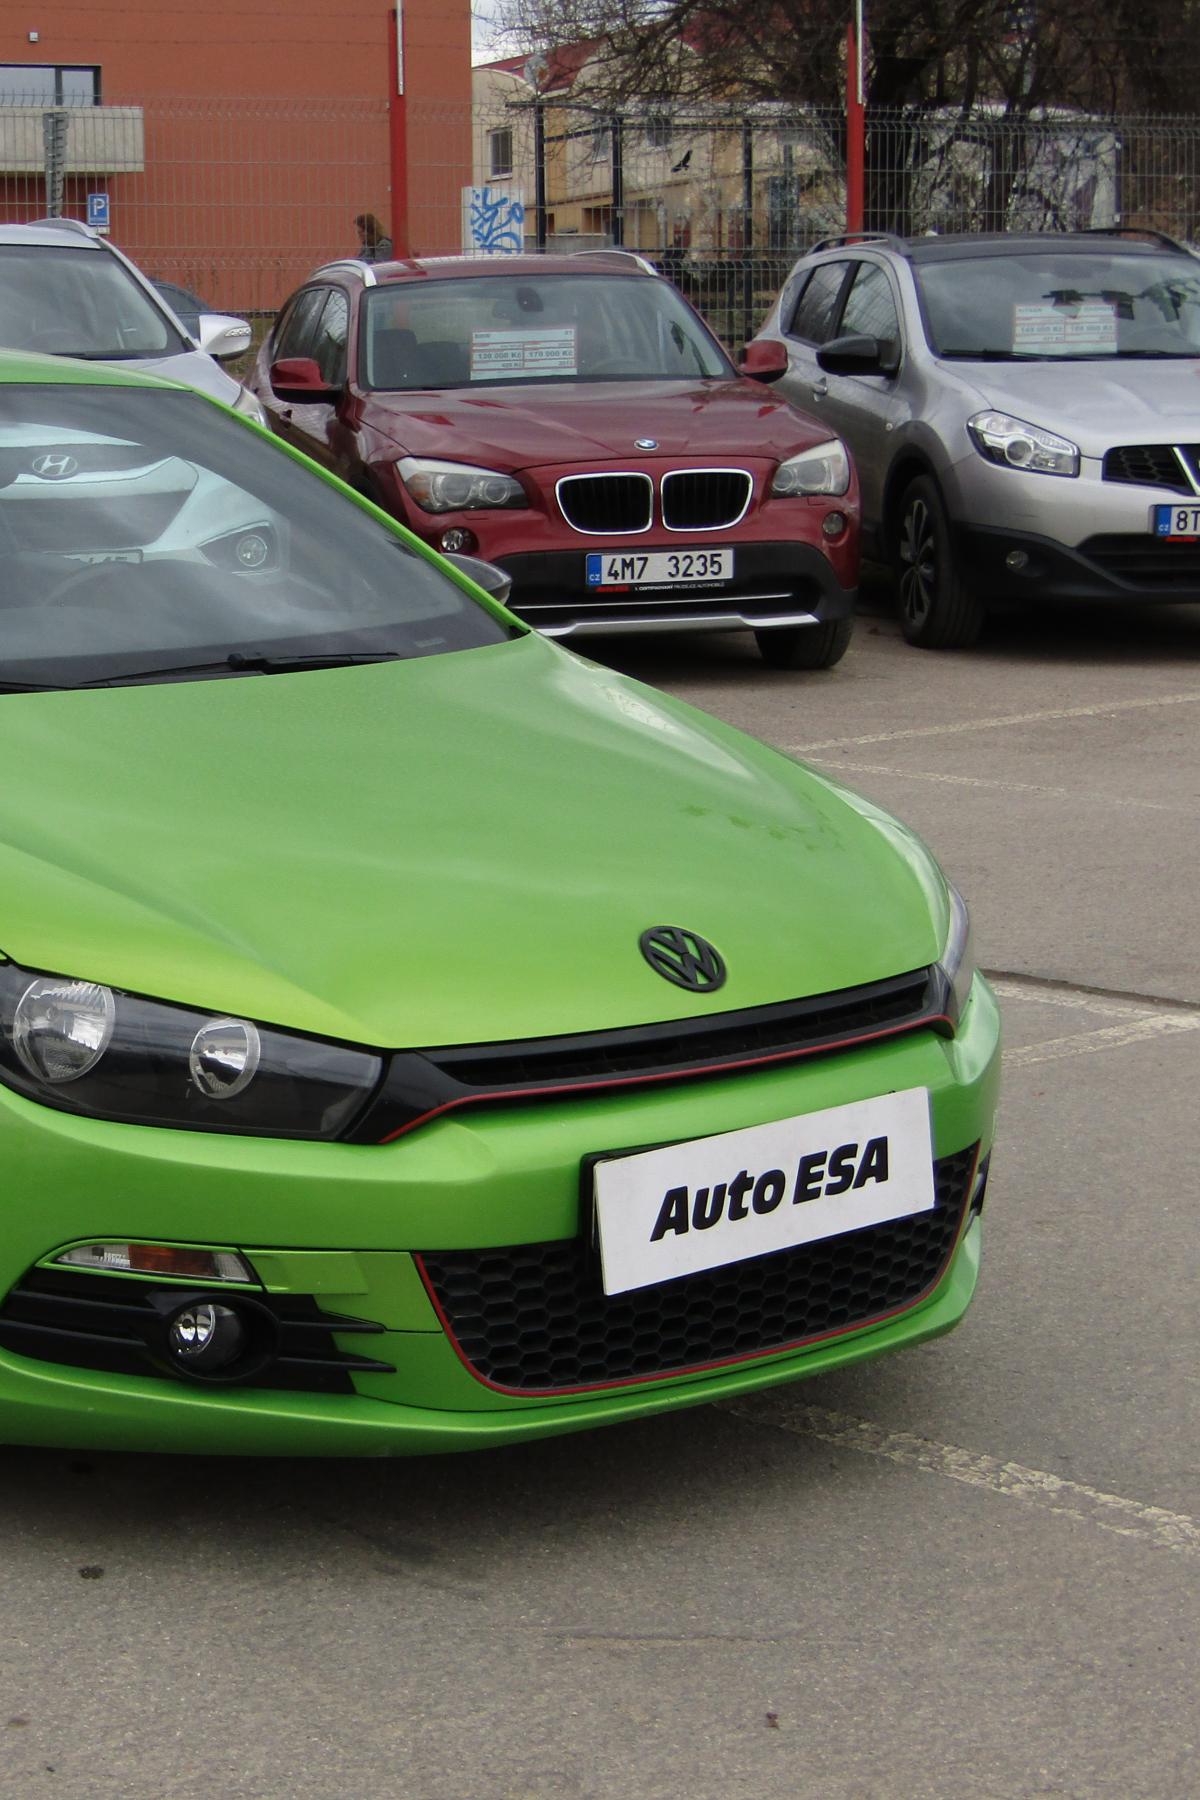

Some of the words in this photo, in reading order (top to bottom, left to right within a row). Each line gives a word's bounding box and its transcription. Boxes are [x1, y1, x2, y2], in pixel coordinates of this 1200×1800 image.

[93, 198, 106, 216] P
[589, 573, 601, 582] CZ
[607, 556, 649, 580] 4M7
[667, 553, 722, 578] 3235
[650, 1168, 786, 1242] Auto
[792, 1135, 889, 1205] ESA
